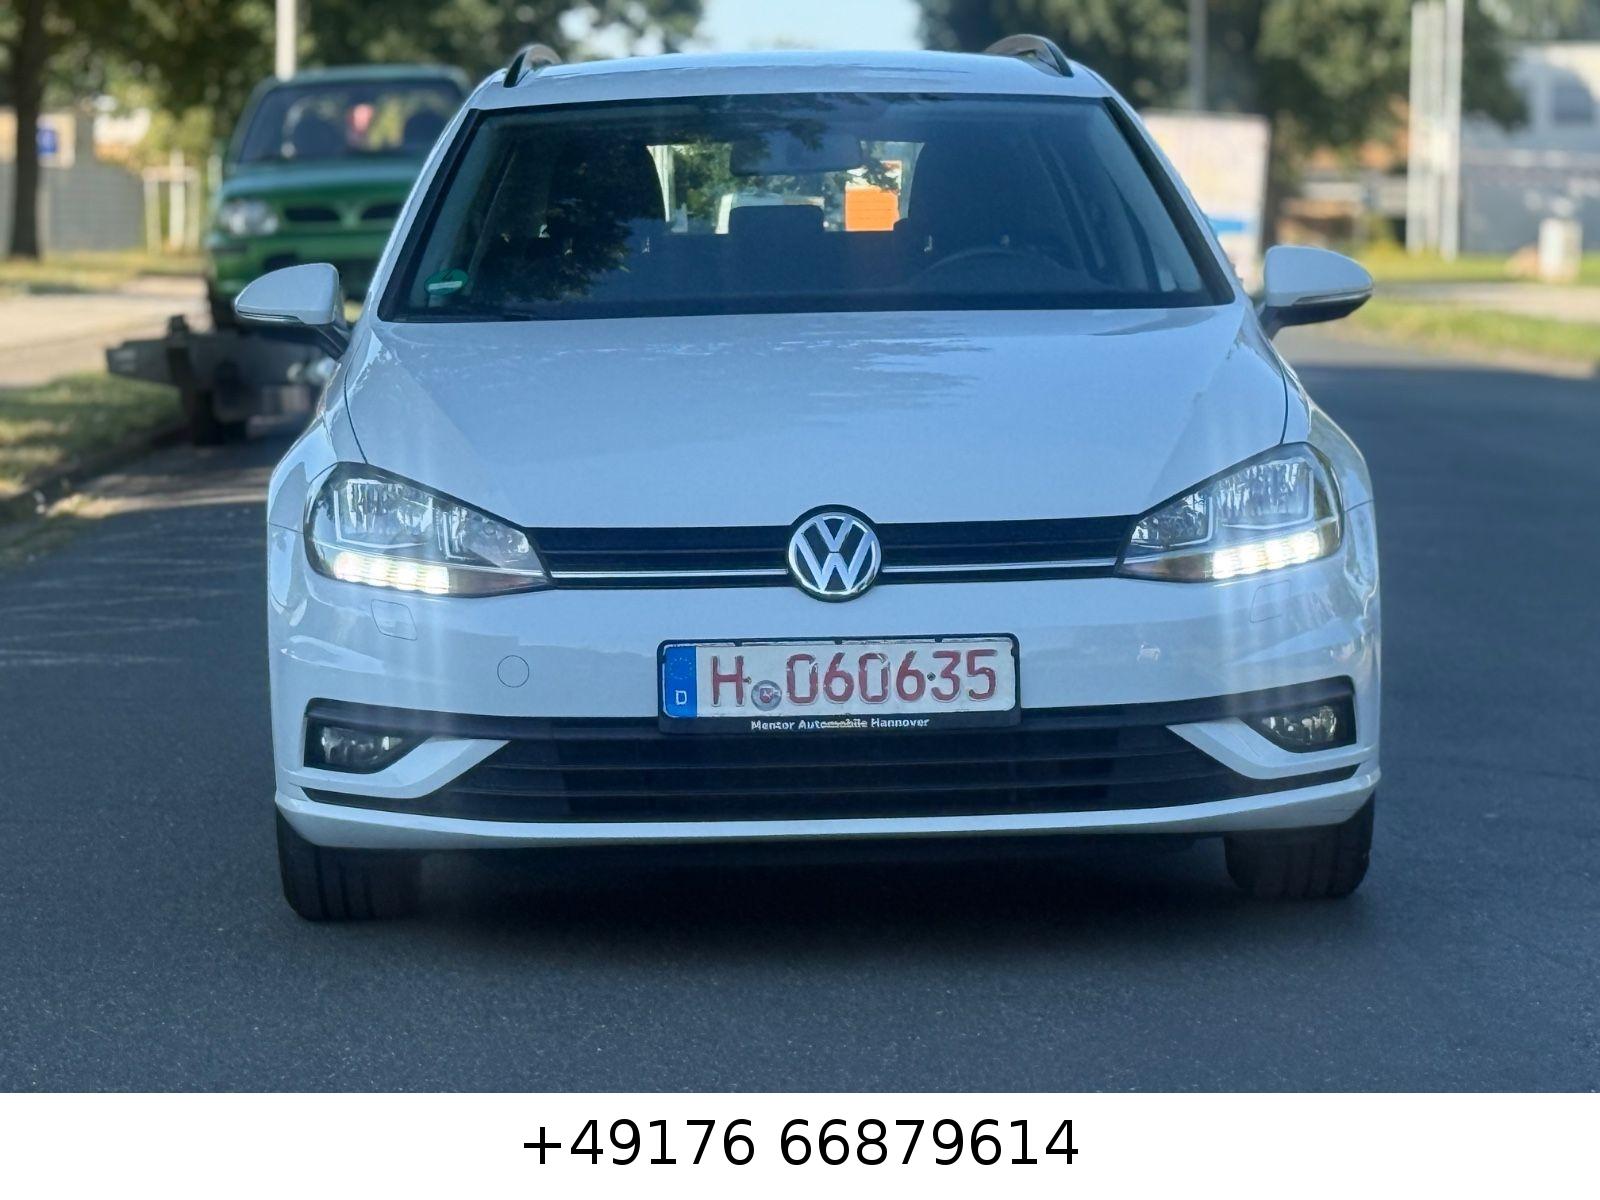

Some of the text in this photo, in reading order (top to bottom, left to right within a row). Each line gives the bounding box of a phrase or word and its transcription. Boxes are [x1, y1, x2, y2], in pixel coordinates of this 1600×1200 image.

[710, 649, 999, 707] H 060635
[675, 690, 688, 705] D
[870, 717, 930, 728] Hannover
